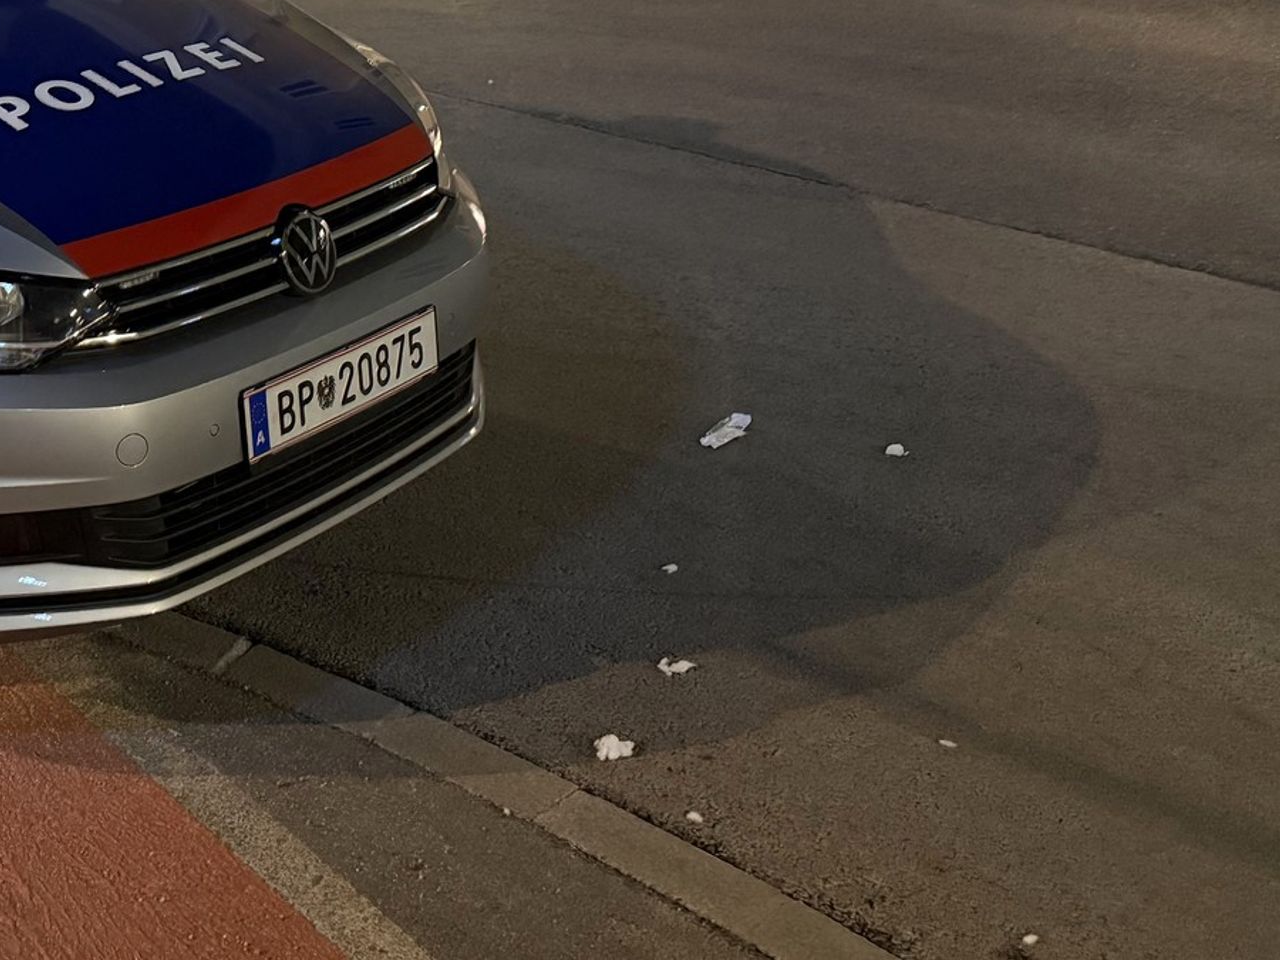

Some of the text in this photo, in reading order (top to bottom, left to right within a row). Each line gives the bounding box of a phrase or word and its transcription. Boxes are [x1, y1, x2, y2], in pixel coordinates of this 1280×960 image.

[277, 326, 424, 436] BP 20875
[256, 429, 266, 447] A
